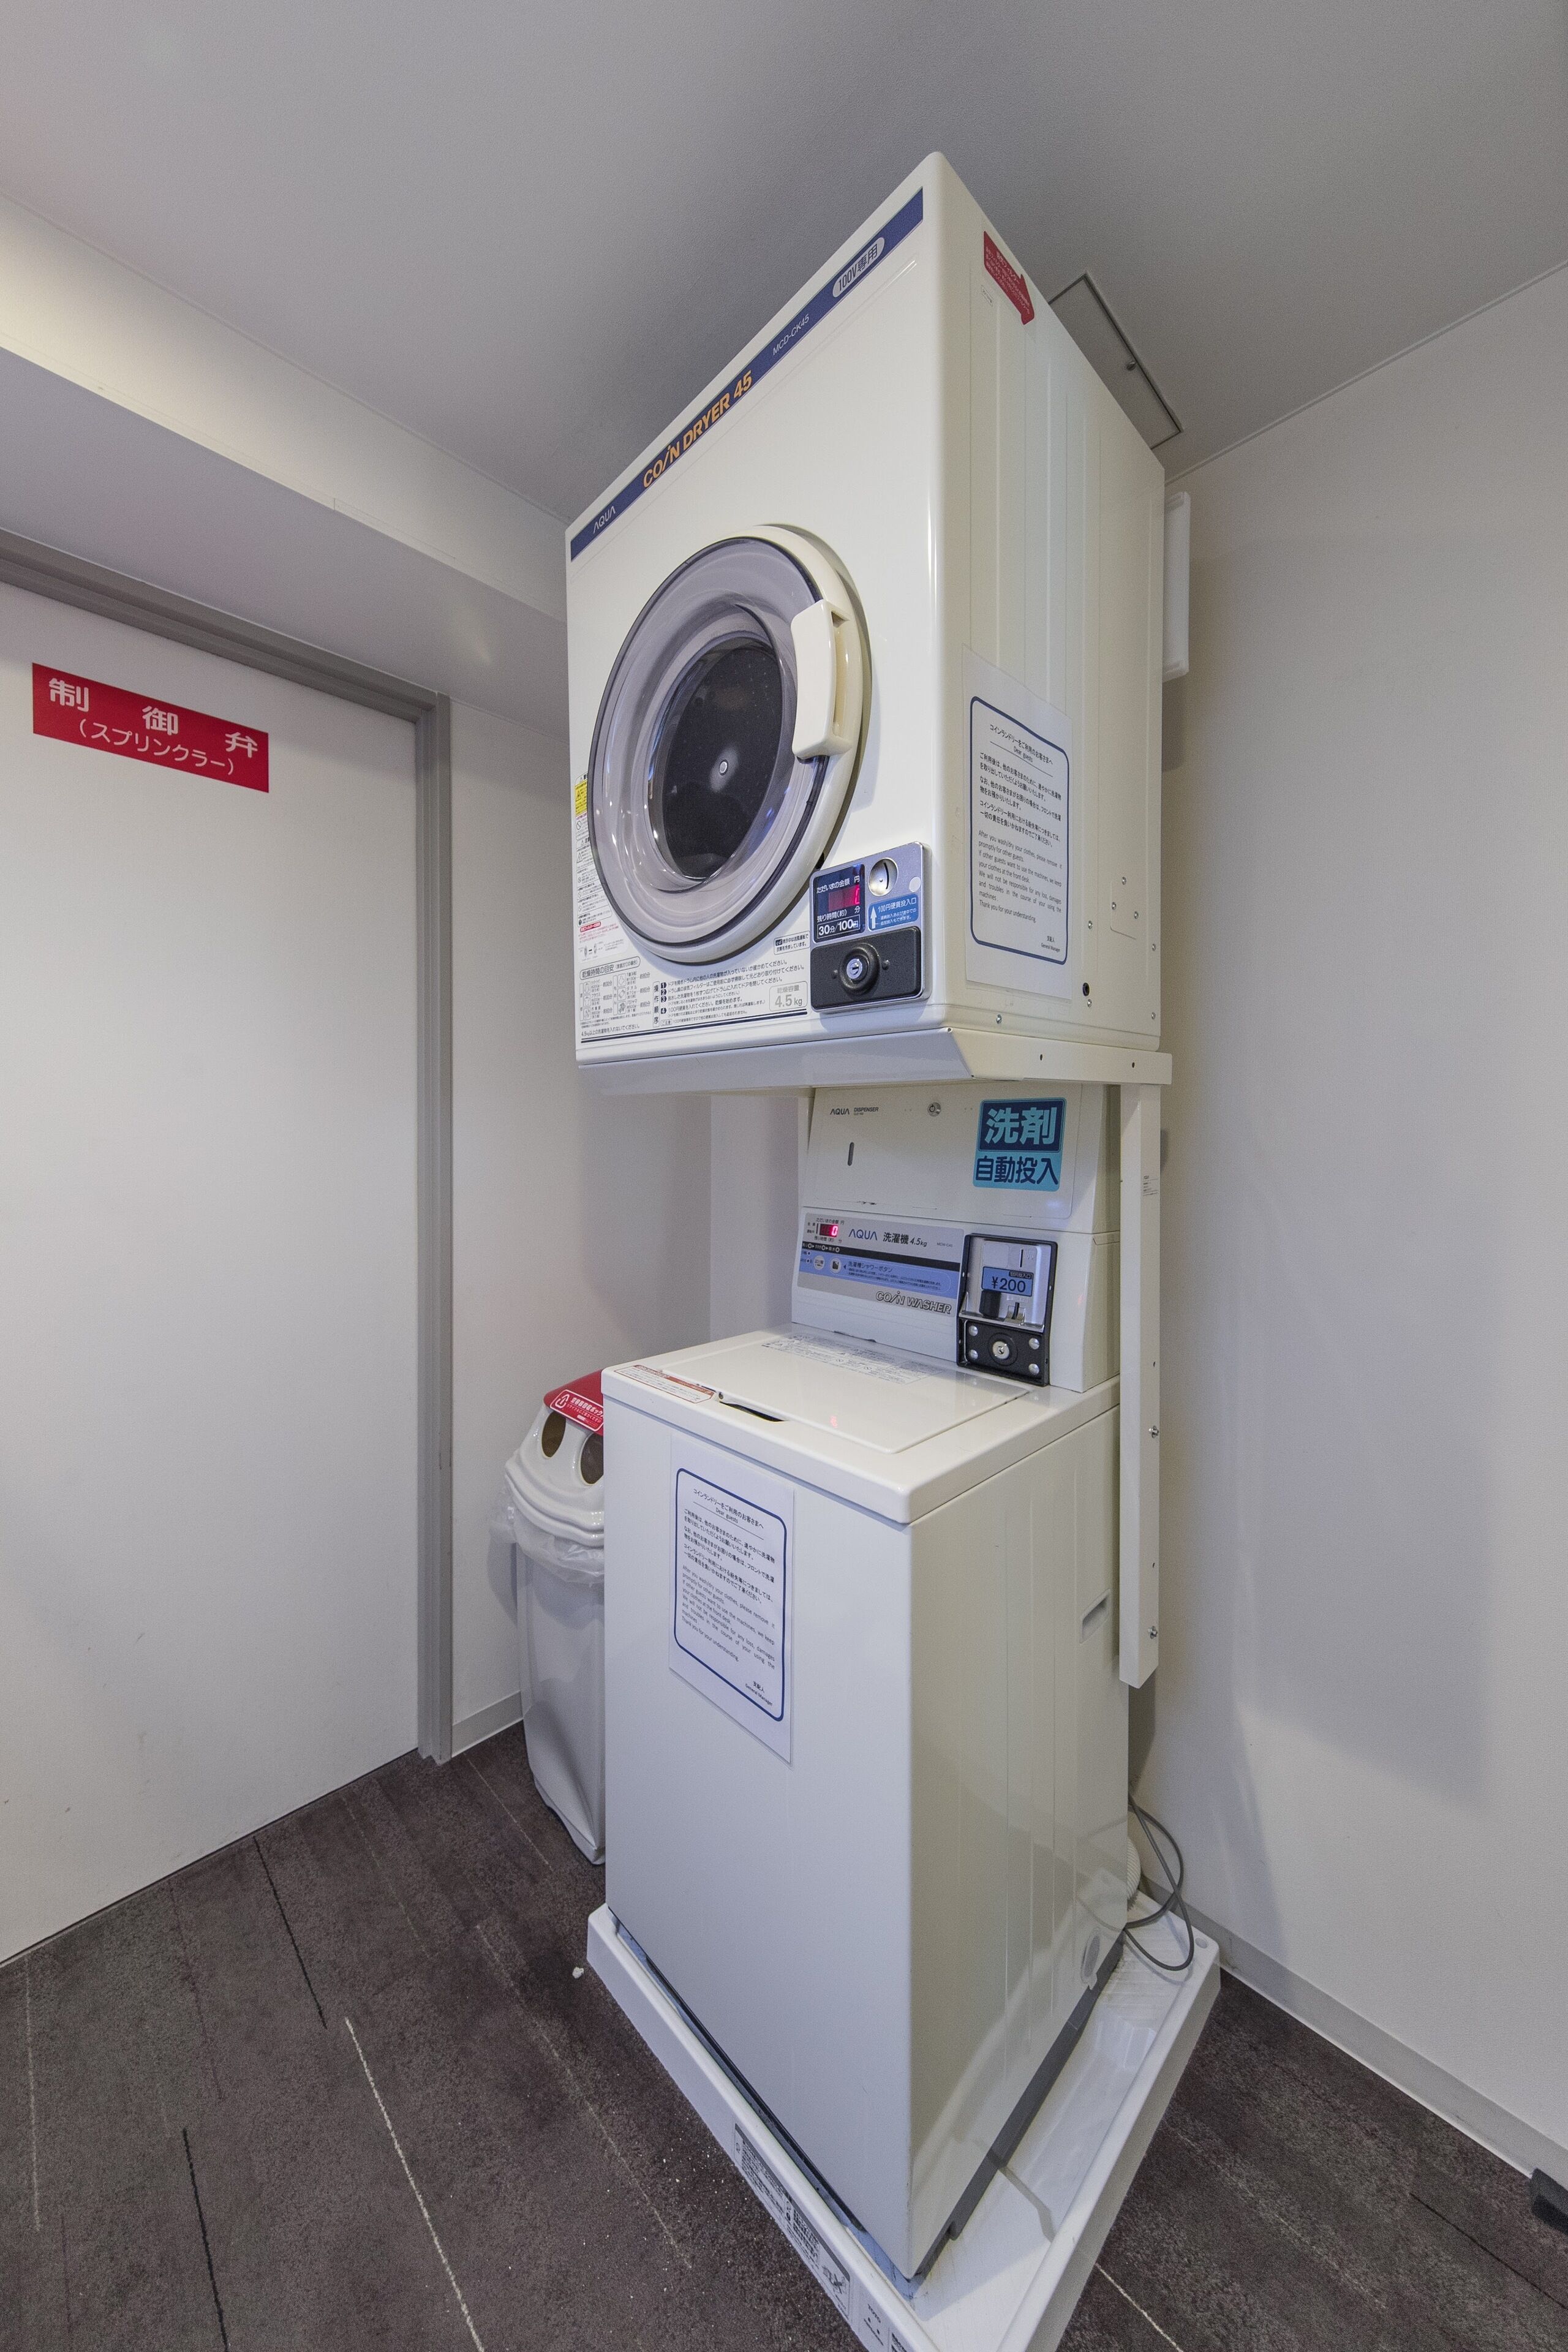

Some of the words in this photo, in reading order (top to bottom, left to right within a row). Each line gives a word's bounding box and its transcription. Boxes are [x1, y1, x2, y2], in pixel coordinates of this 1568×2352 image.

[594, 505, 616, 533] AQUA
[684, 393, 729, 451] DRYER
[733, 371, 752, 399] 45
[773, 314, 809, 355] MCD-CK45
[839, 244, 878, 292] 100V専用
[80, 719, 233, 775] (スプリンクラー)
[990, 724, 1053, 765] コインランドリーをご利用のお客さまへ
[1023, 752, 1033, 763] guests
[982, 851, 992, 860] other
[994, 856, 1005, 866] guests
[816, 878, 850, 894] ただいまの金額
[878, 897, 916, 913] 100円硬貨投入口
[817, 909, 847, 922] 残り時間(約)
[819, 919, 859, 935] 30分/100円
[582, 965, 614, 978] 乾燥時間の目安
[775, 995, 791, 1007] 4.5
[985, 1107, 1057, 1145] 洗剤
[976, 1156, 1058, 1186] 自動投入
[832, 1226, 839, 1236] 0
[849, 1228, 878, 1241] AQUA
[883, 1232, 909, 1245] 洗濯機
[910, 1237, 927, 1247] 4.5kg
[992, 1276, 1026, 1292] ¥200
[907, 1295, 952, 1314] WASHER
[693, 1488, 763, 1529] コインランドリーをご利用のお客さまへ
[715, 1507, 724, 1515] Dear
[739, 1602, 752, 1614] please
[753, 1611, 768, 1625] remove
[756, 1645, 774, 1662] damages
